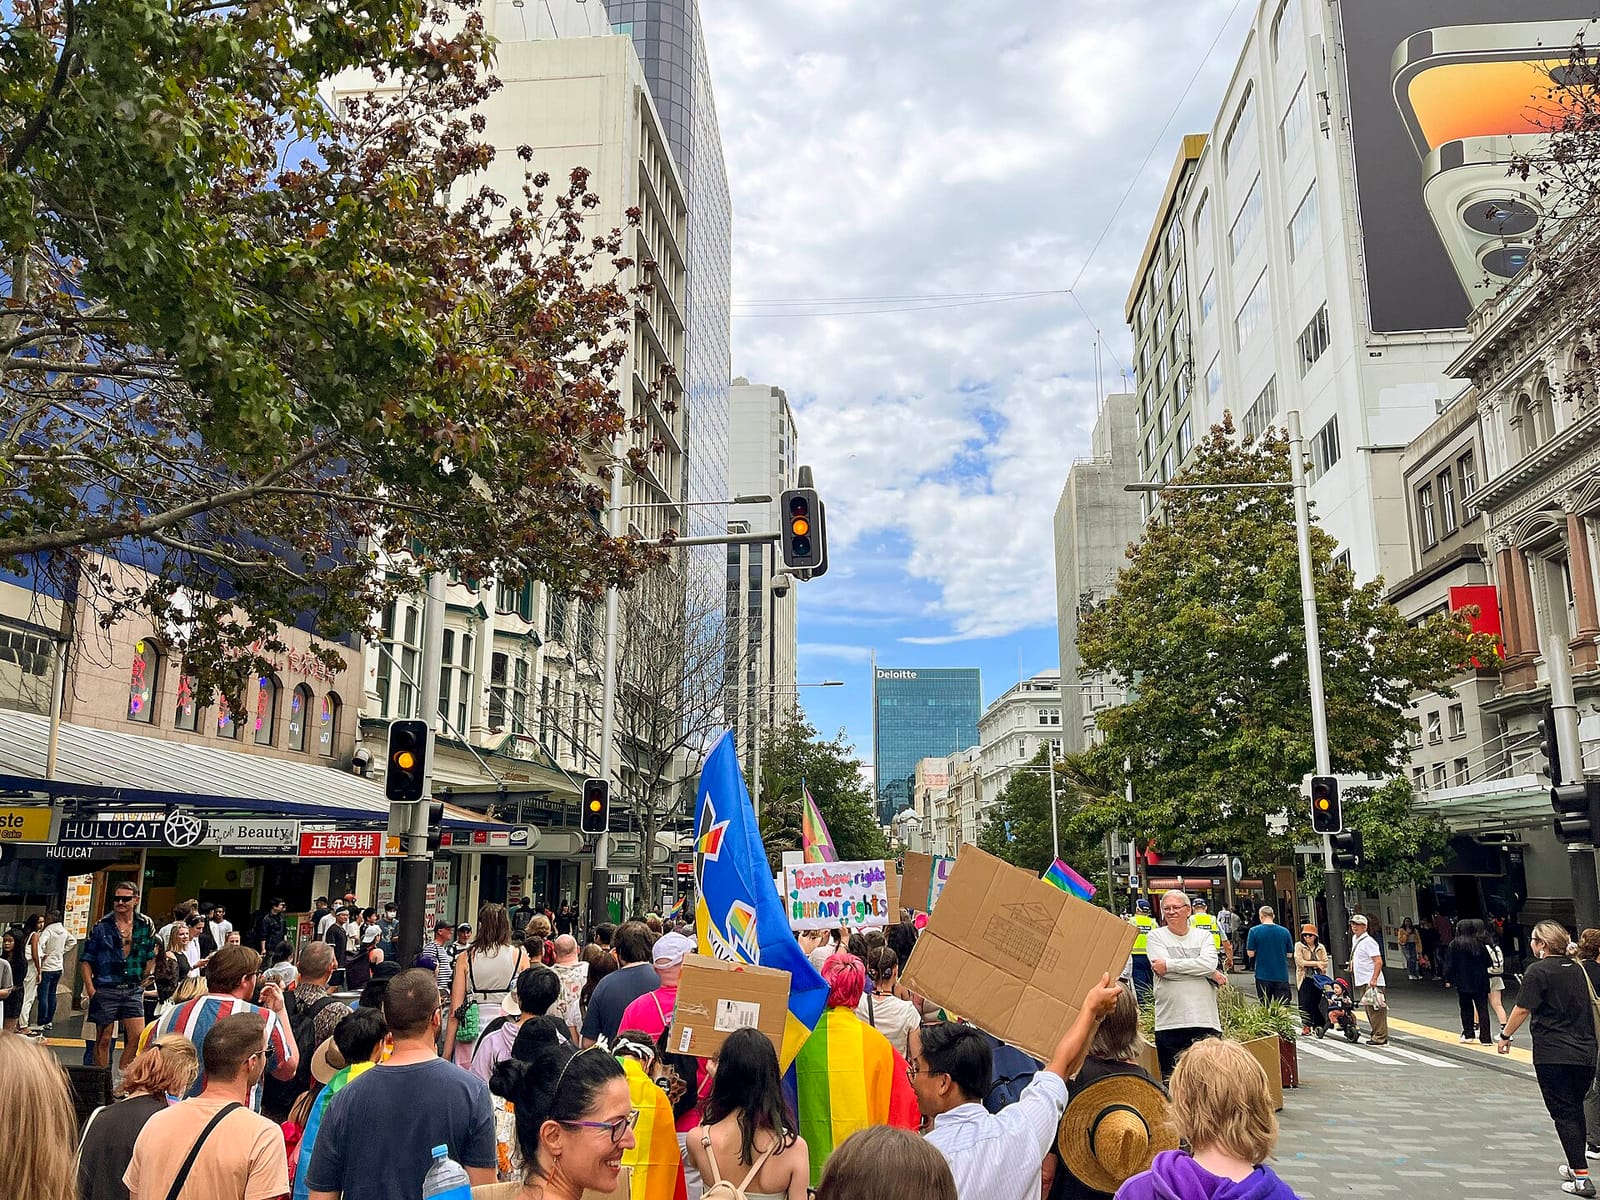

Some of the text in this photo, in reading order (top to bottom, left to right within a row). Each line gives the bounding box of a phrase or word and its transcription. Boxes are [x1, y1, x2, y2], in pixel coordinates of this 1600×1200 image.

[877, 670, 918, 679] Deloitte
[65, 822, 161, 838] HULUCAT
[237, 825, 289, 841] Beauty
[311, 834, 374, 850] 正新鸡排
[46, 846, 94, 858] HULUCAT
[795, 866, 886, 890] Rainbow rights
[818, 887, 842, 897] are
[842, 894, 888, 923] rights
